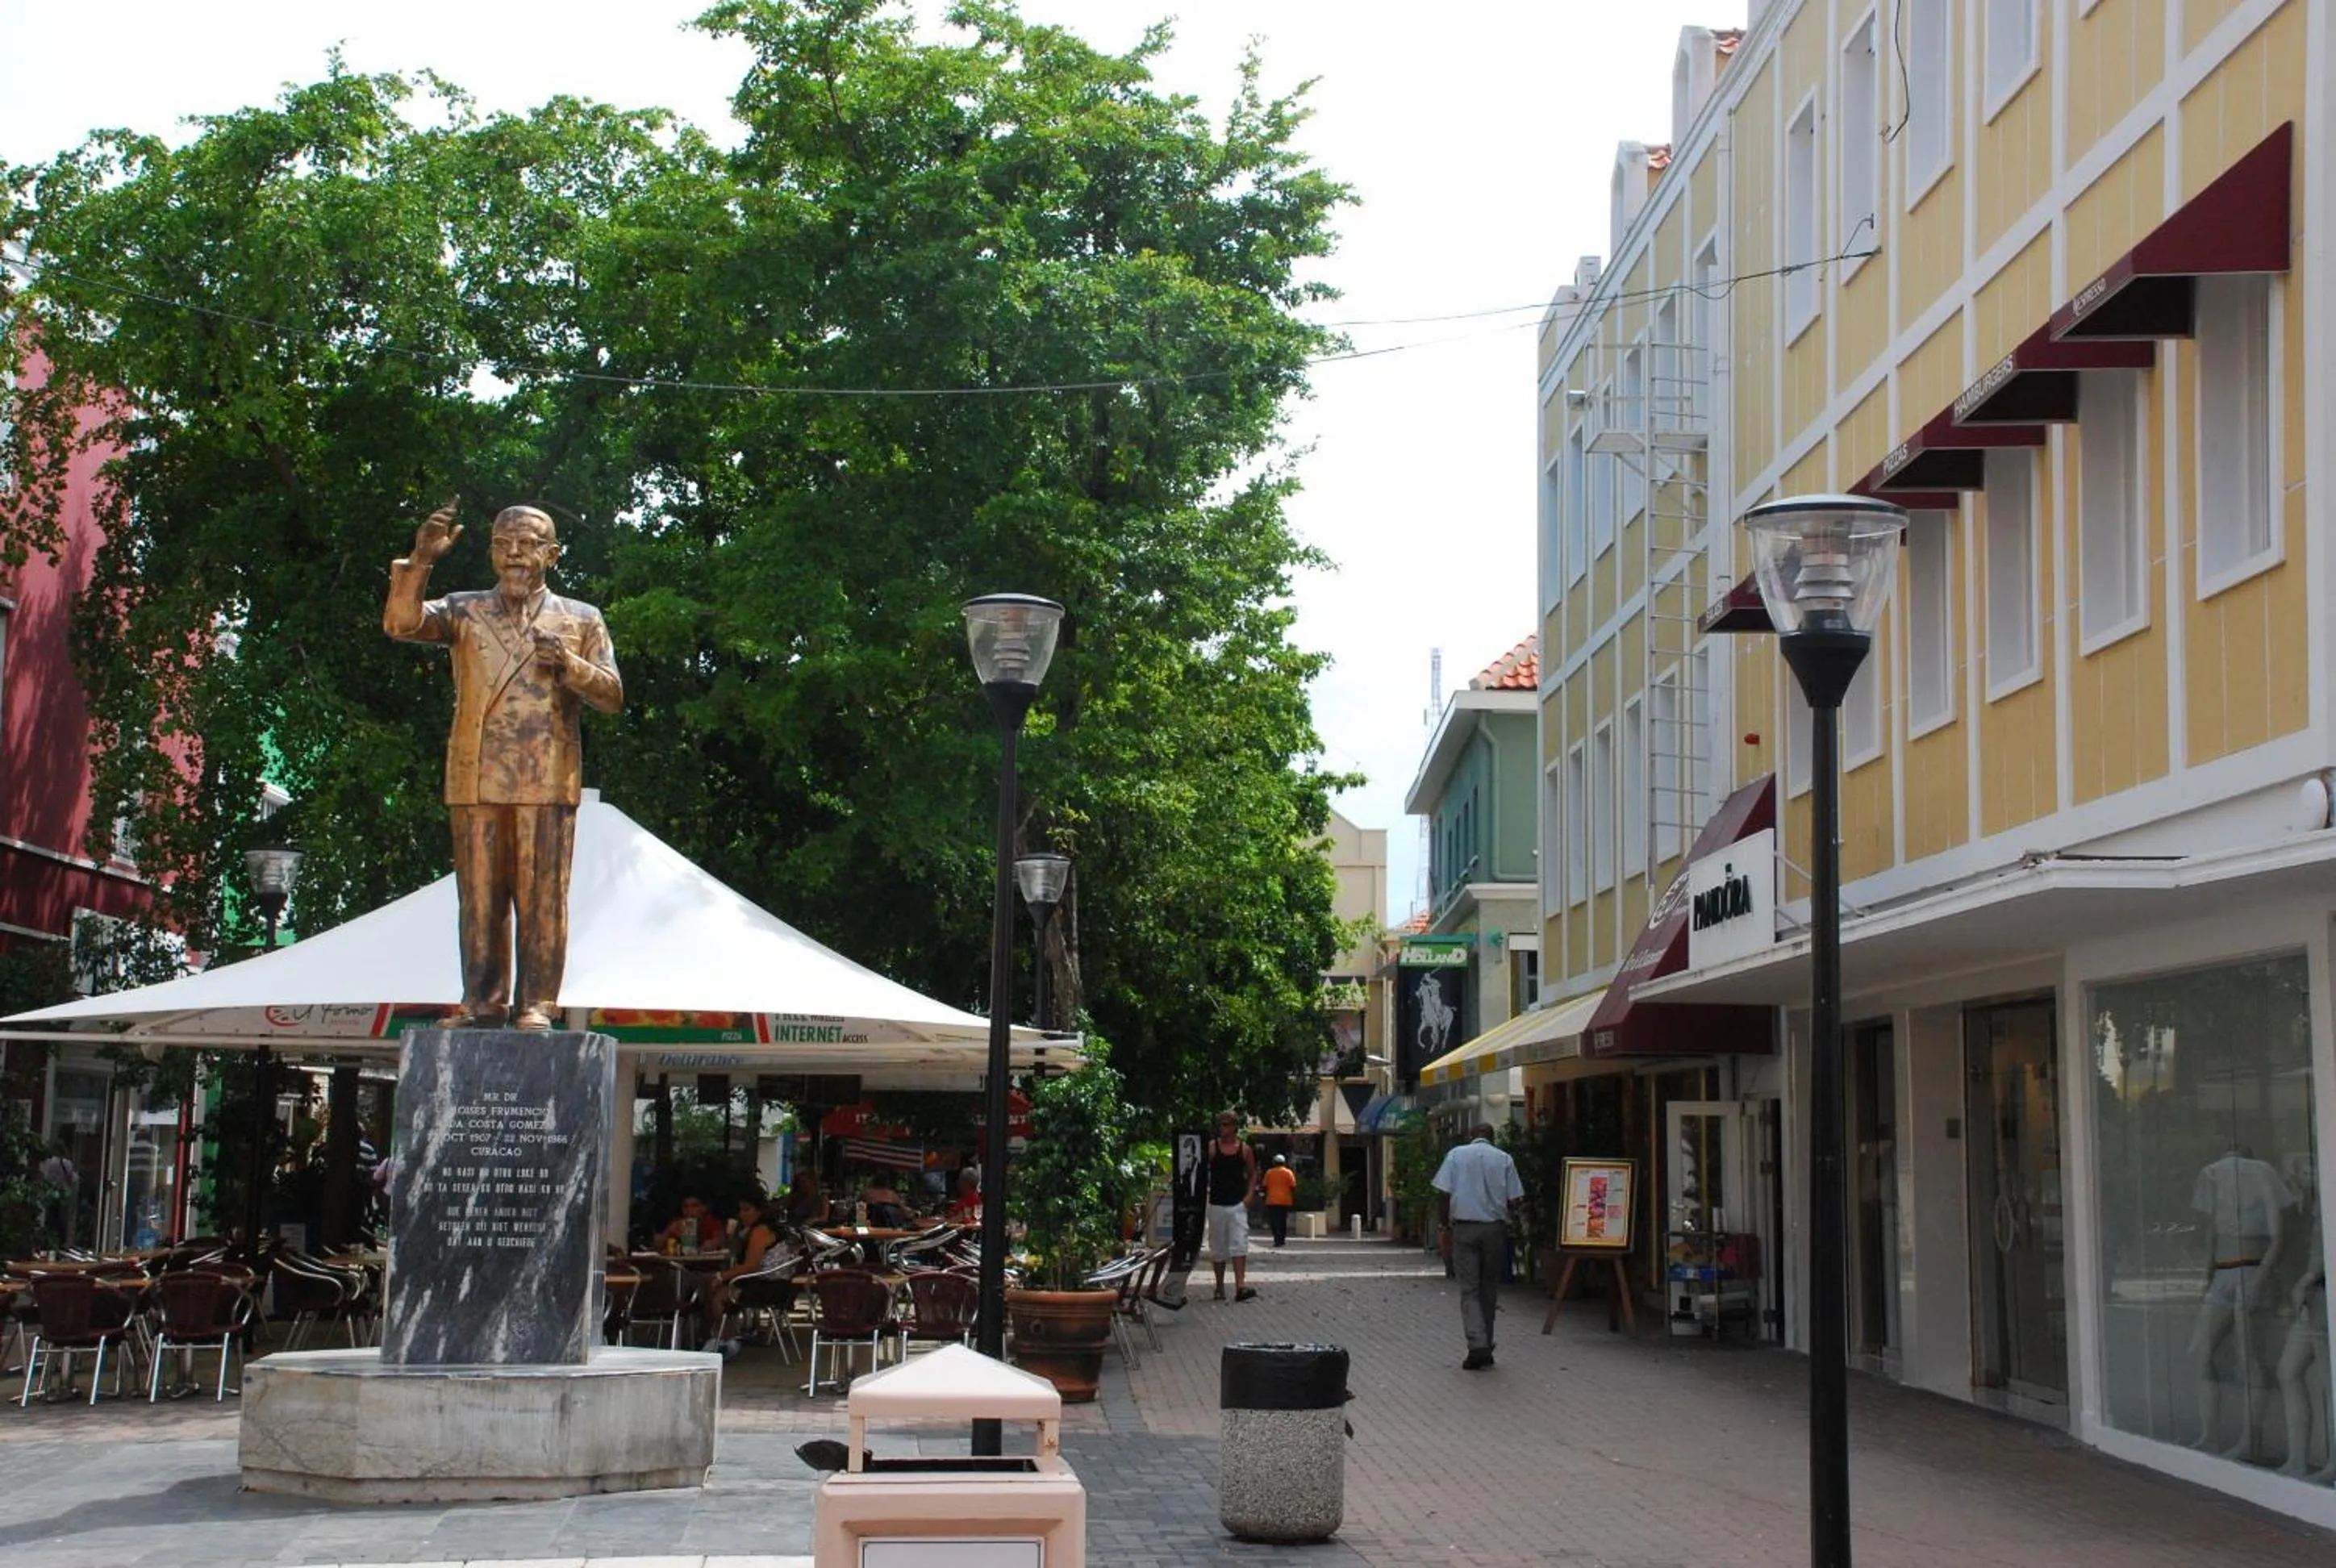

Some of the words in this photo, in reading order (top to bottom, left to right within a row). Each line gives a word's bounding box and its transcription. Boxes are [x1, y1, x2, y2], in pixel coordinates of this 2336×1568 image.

[1954, 354, 2014, 418] HAMBURGERS
[1692, 874, 1752, 932] PANDORA
[774, 1025, 842, 1043] INTERNET
[842, 1033, 870, 1043] ACCESS
[469, 1120, 504, 1129] COSTA
[509, 1120, 547, 1130] GOMEZ
